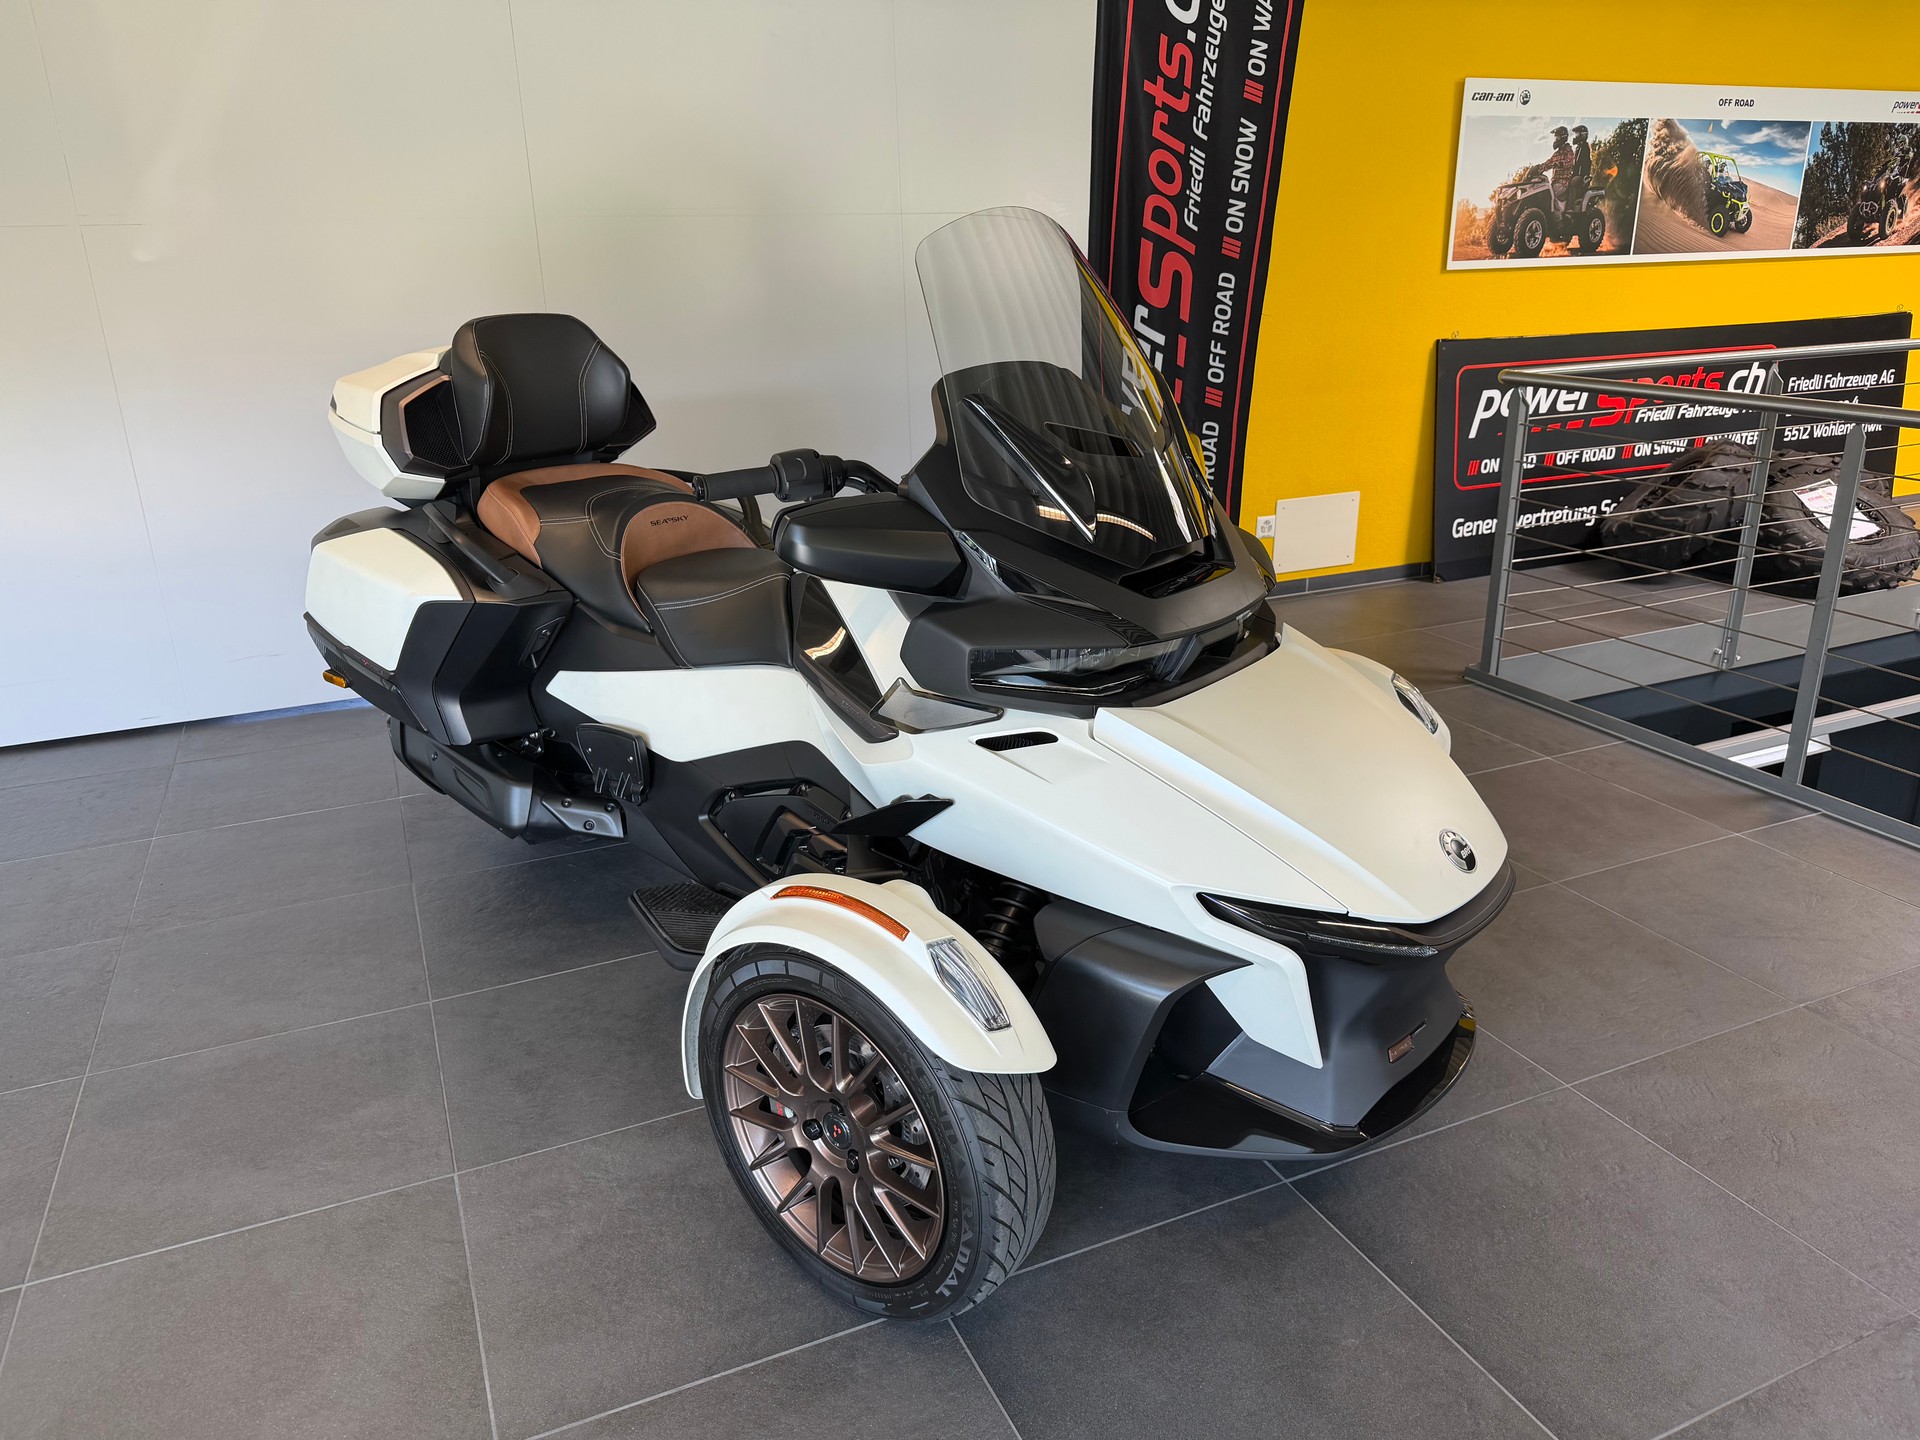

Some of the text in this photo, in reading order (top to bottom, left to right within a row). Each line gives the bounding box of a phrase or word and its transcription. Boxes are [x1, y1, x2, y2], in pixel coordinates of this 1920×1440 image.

[1247, 38, 1269, 76] ON
[1471, 92, 1515, 102] can-am
[1718, 98, 1755, 107] OFF ROAD
[1891, 101, 1920, 113] power
[1184, 0, 1228, 232] Friedli Fahrzeuge
[1231, 117, 1258, 194] SNOW
[1225, 198, 1246, 233] ON
[1212, 272, 1236, 336] ROAD
[1207, 339, 1228, 384] OFF
[1787, 369, 1895, 392] Friedli Fahrzeuge AG
[1635, 405, 1677, 423] Friedli
[1783, 425, 1811, 441] 5512
[1480, 458, 1500, 474] ON
[1556, 450, 1580, 465] OFF
[1582, 447, 1616, 463] ROAD
[1634, 443, 1651, 457] ON
[1653, 439, 1688, 455] SNOW
[1452, 505, 1597, 538] Genervertretung
[933, 1200, 975, 1297] RADIAL
